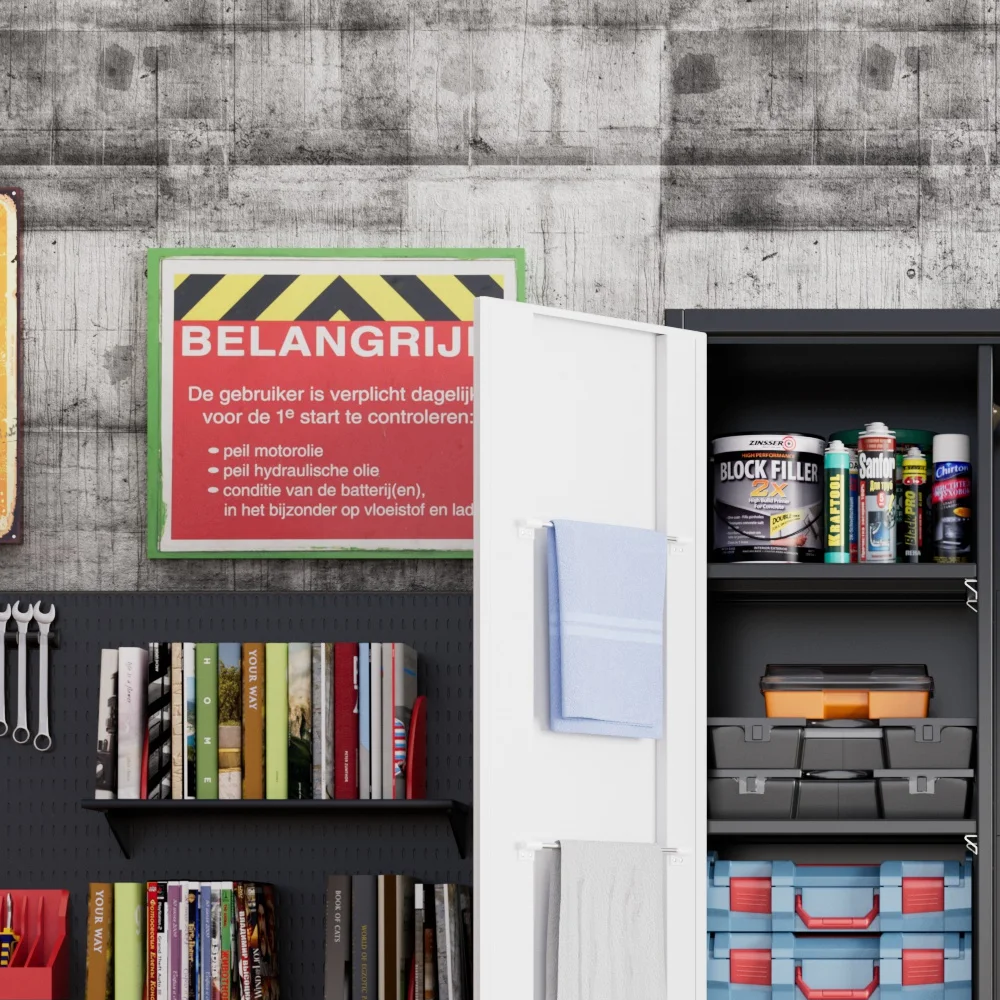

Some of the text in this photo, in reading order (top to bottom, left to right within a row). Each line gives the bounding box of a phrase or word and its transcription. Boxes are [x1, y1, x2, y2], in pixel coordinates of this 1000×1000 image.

[181, 325, 474, 358] BELANGRIJ
[188, 385, 214, 402] De
[219, 385, 305, 406] gebruiker
[309, 385, 325, 402] is
[329, 385, 406, 406] verplicht
[202, 411, 243, 425] voor
[247, 408, 271, 425] de
[299, 409, 340, 425] start
[345, 409, 362, 425] te
[367, 408, 474, 425] controleren:
[223, 443, 324, 461] peil motorolie
[223, 463, 380, 480] peil hydraulische olie
[720, 459, 818, 482] BLOCK FILLER
[859, 452, 896, 479] Sanfor
[935, 464, 969, 478] Chirton
[222, 483, 426, 500] conditie van de batterij(en),
[223, 503, 237, 517] in
[241, 503, 265, 517] het
[269, 503, 337, 520] bijzonder
[341, 505, 360, 520] op
[364, 503, 426, 517] vloeistof
[429, 505, 448, 517] en
[828, 473, 844, 547] KRAFTOOL
[249, 650, 258, 710] YOUR WAY
[93, 889, 104, 953] YOUR WAY
[149, 899, 157, 950] Фотосессия
[334, 890, 342, 943] BOOK OF CATS
[238, 910, 248, 958] ВЛАДИМИР
[360, 924, 368, 950] WORLD
[149, 951, 157, 978] Елены
[360, 951, 368, 961] OF
